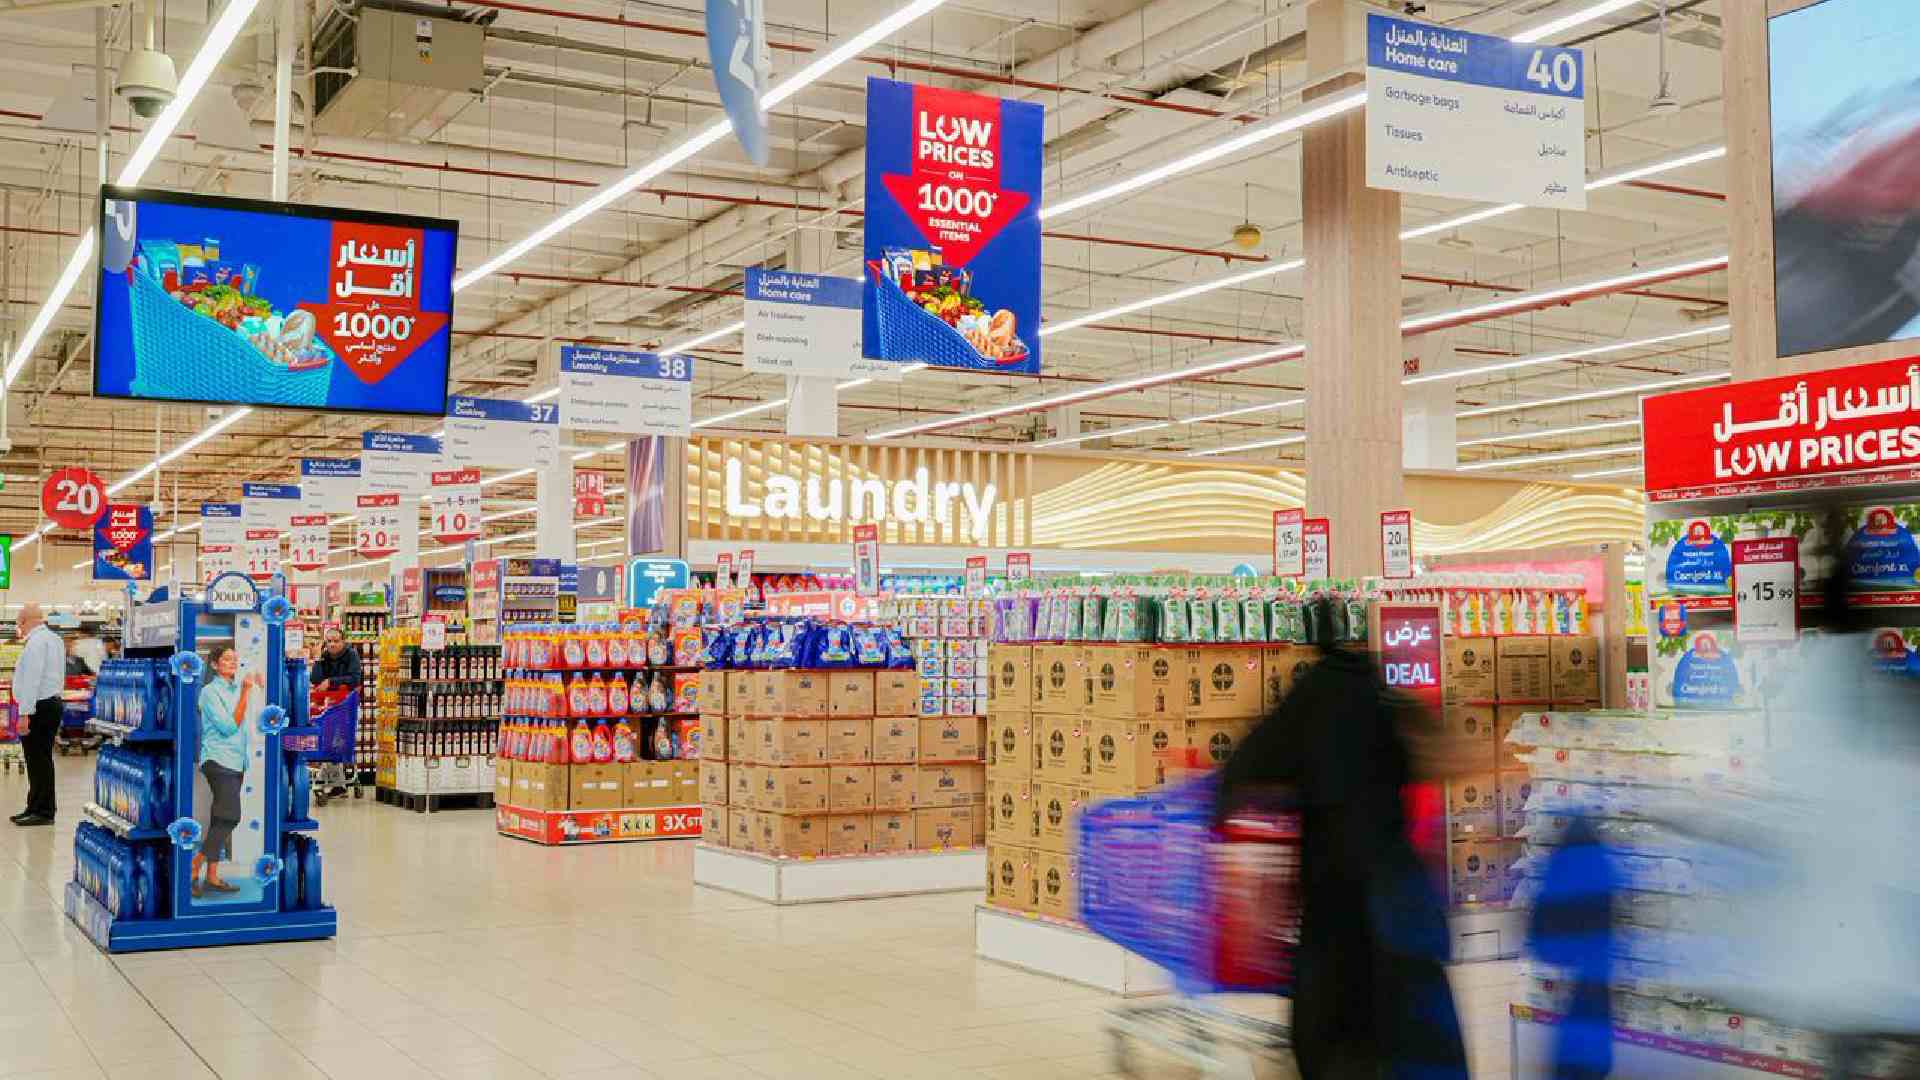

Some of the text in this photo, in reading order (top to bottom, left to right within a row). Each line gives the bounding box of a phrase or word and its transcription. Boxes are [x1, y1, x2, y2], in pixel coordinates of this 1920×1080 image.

[1386, 24, 1467, 54] العناية بالمنزل
[1386, 48, 1457, 73] Home care
[1526, 50, 1577, 92] 40
[1385, 87, 1459, 111] Garbage bags
[919, 111, 992, 148] LOW
[1385, 125, 1423, 142] Tissues
[918, 141, 994, 169] PRICES
[948, 170, 964, 181] ON
[1386, 165, 1440, 182] Antiseptic
[928, 217, 982, 233] ESSENTIAL
[939, 230, 970, 242] ITEMS
[336, 238, 415, 268] أسعار
[336, 268, 413, 298] أقل
[758, 286, 812, 301] Home care
[657, 357, 687, 378] 38
[531, 403, 554, 421] 37
[1712, 364, 1920, 443] أسعار أقل
[1714, 425, 1920, 479] LOW PRICES
[56, 479, 100, 515] 20
[726, 457, 997, 541] Laundry
[360, 531, 388, 548] 20
[1385, 620, 1433, 647] عرض
[1385, 662, 1436, 687] DEAL
